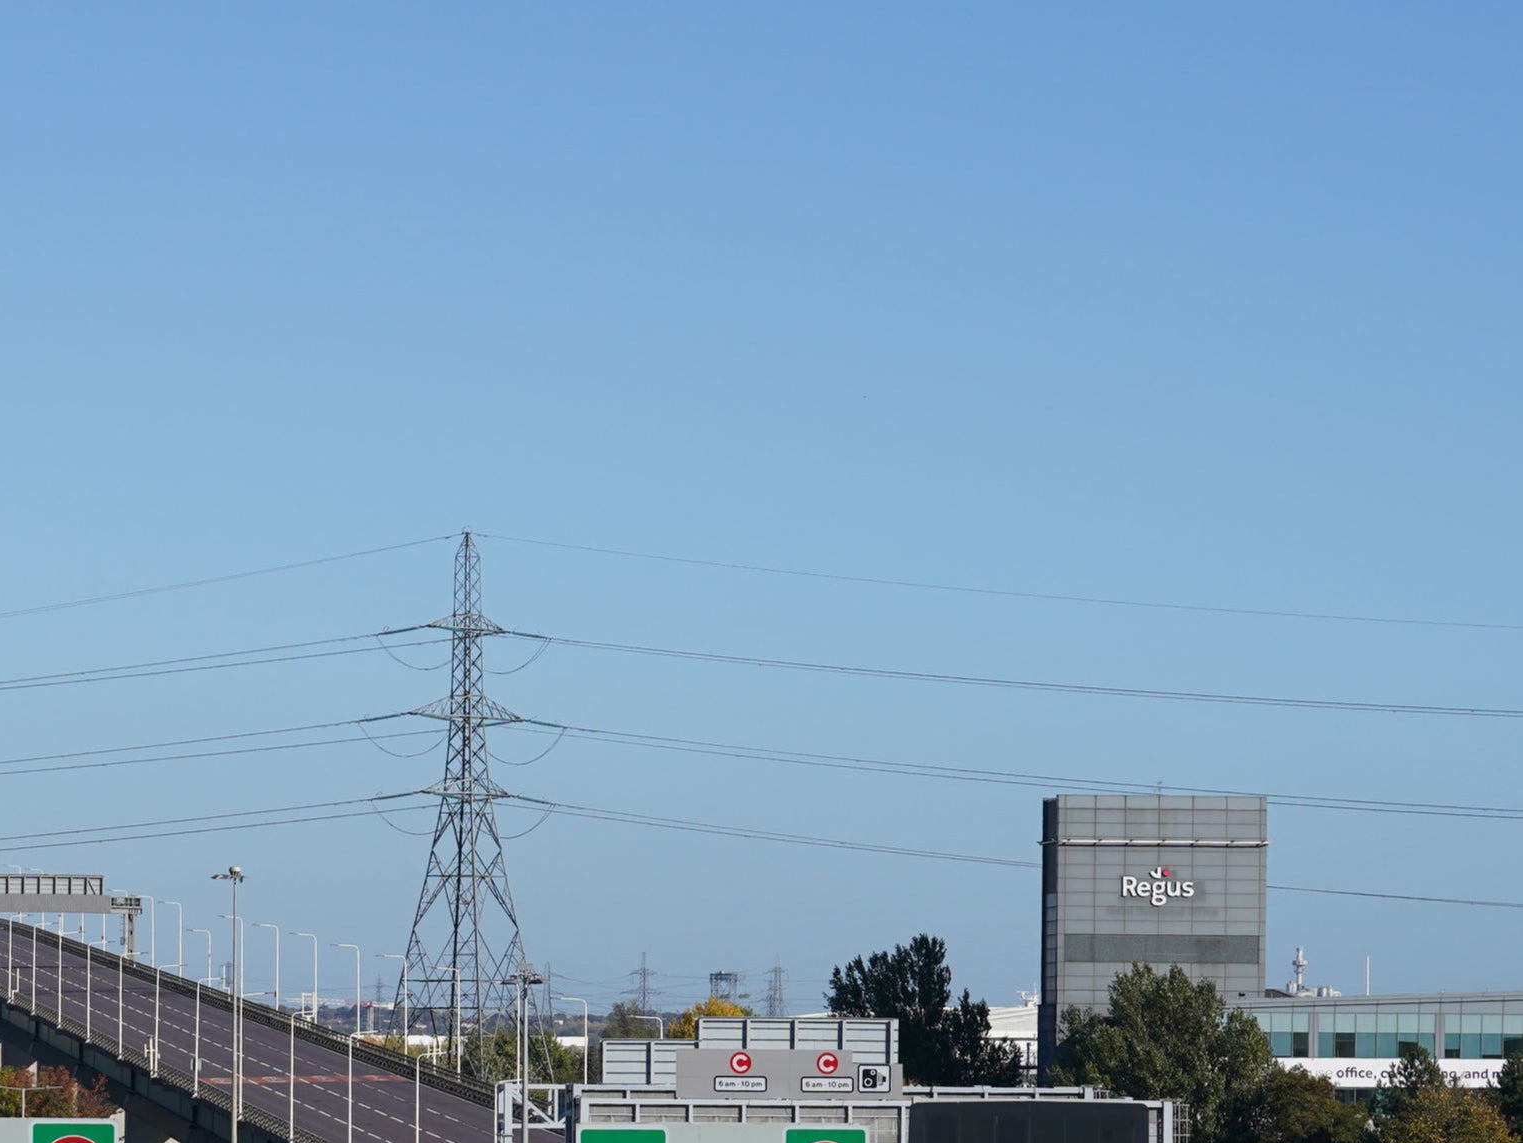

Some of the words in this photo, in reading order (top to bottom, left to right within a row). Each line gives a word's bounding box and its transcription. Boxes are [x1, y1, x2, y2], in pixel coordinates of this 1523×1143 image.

[1122, 875, 1195, 906] Regus
[1336, 1066, 1377, 1080] office,
[1466, 1068, 1489, 1080] and
[751, 1081, 763, 1089] pm
[838, 1082, 850, 1090] pm
